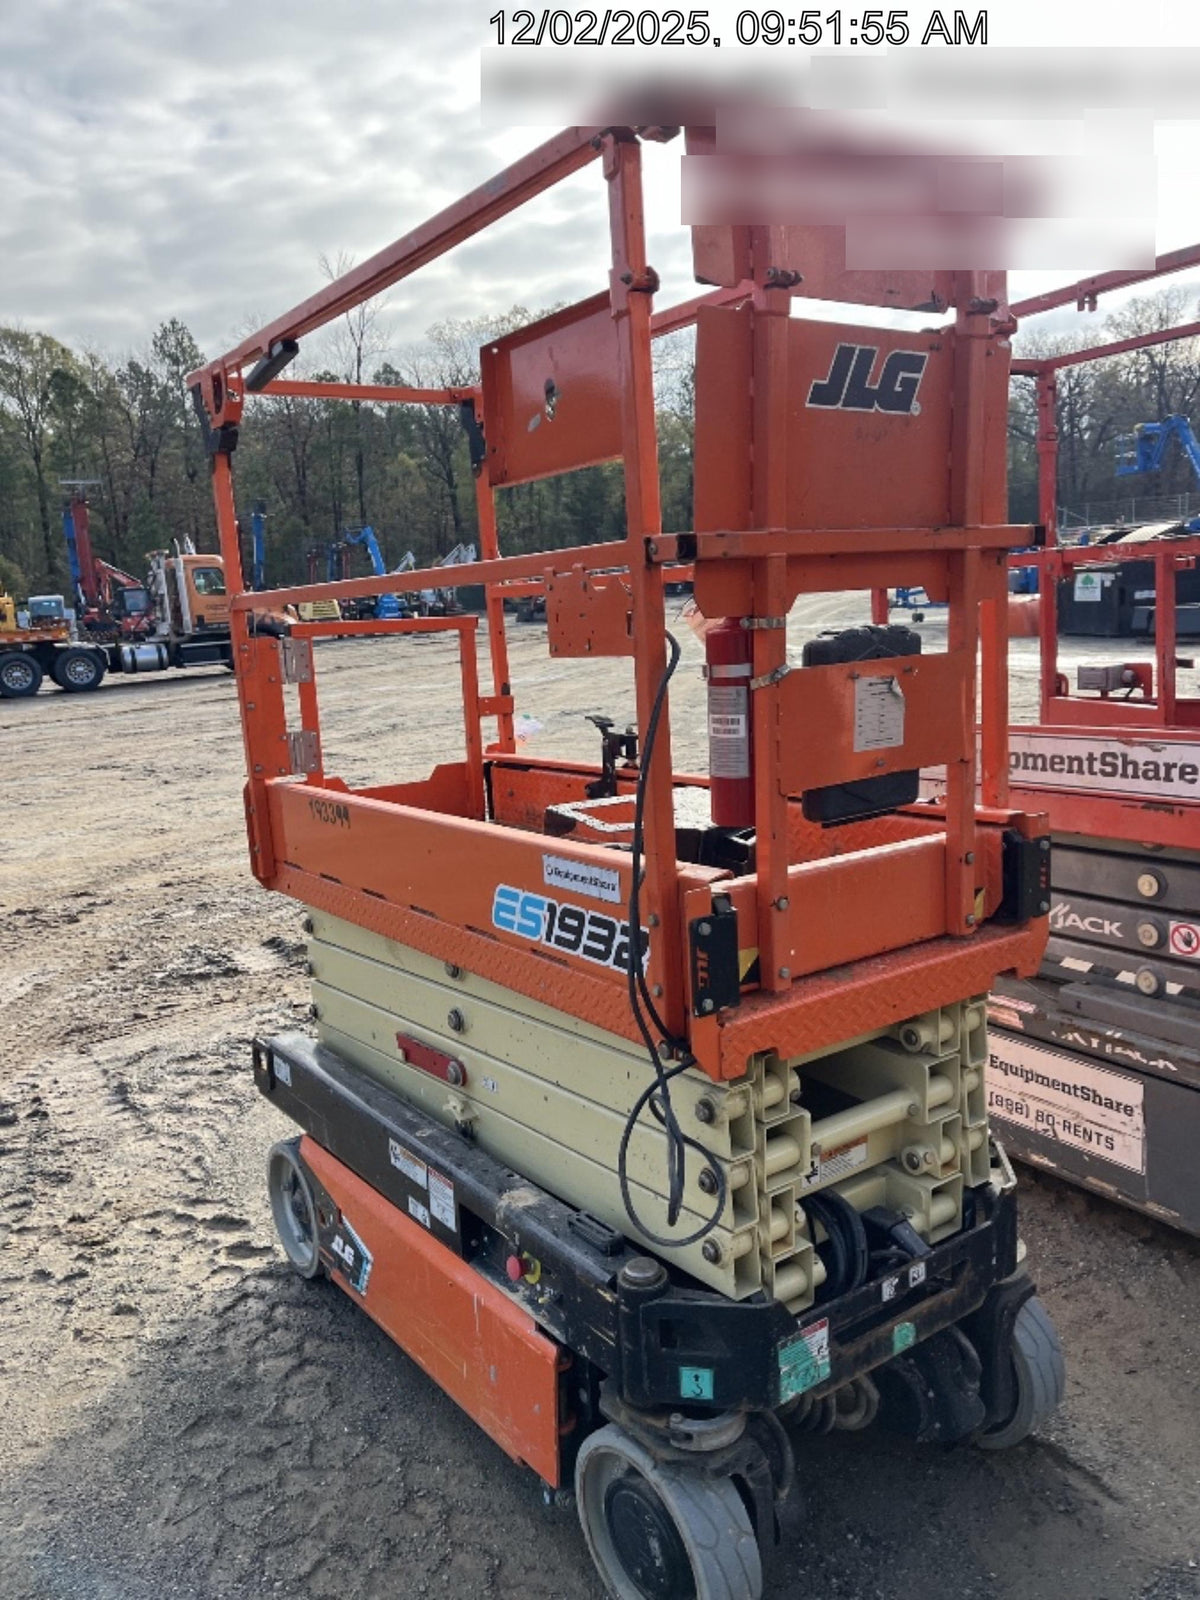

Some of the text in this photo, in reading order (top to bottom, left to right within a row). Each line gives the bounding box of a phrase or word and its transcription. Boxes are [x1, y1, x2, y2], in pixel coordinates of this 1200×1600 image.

[805, 342, 928, 415] JLG
[1009, 751, 1199, 785] pmentShare
[492, 885, 651, 977] ES1932
[989, 1053, 1134, 1118] EquipmentShare
